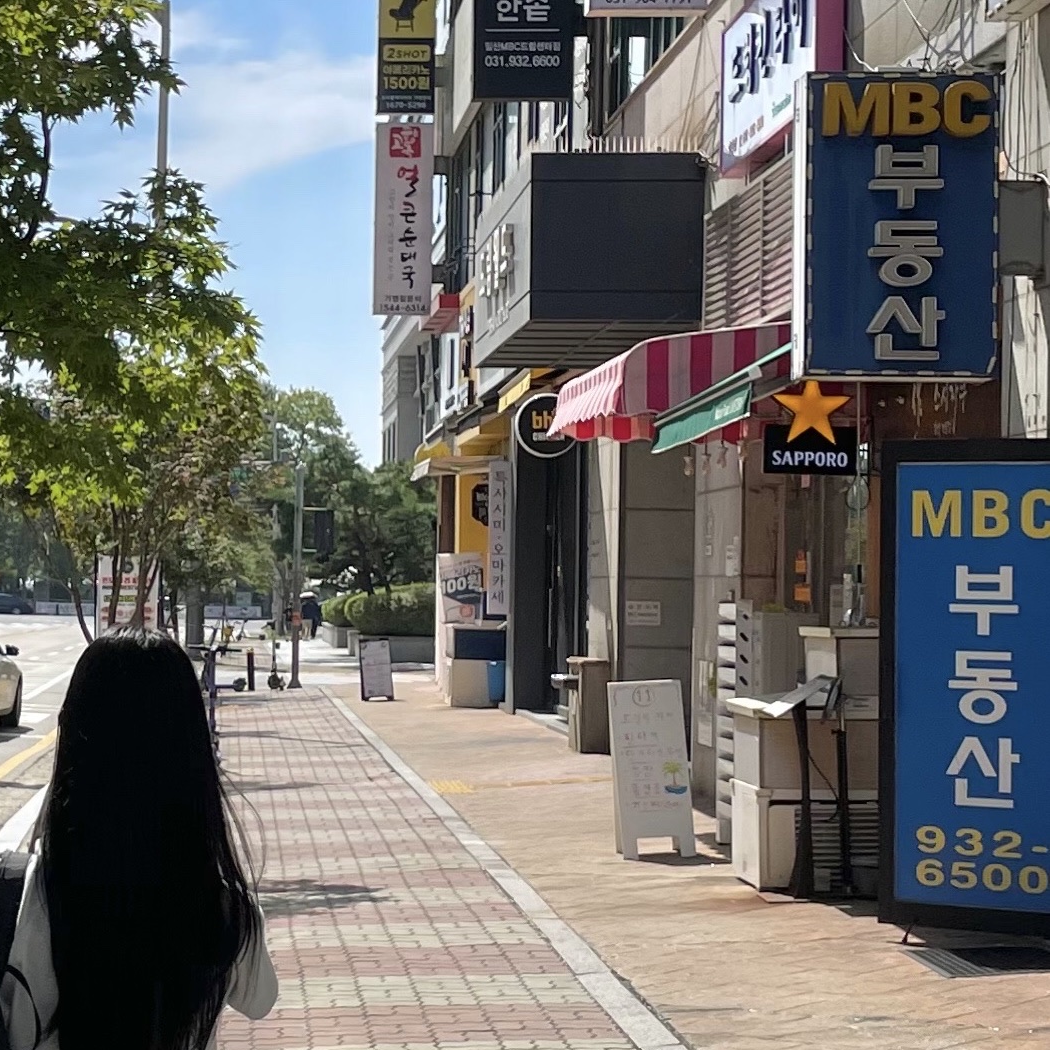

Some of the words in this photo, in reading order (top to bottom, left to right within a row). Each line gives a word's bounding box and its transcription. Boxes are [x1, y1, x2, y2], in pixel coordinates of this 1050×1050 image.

[387, 48, 427, 59] 2SHOT
[484, 55, 560, 68] 031.932.6600
[383, 76, 430, 90] 1500원
[821, 80, 992, 137] MBC
[865, 144, 946, 361] 부동산
[532, 410, 556, 430] bh
[772, 450, 848, 468] SAPPORO
[912, 488, 1050, 540] MBC
[946, 565, 1020, 809] 부동산
[915, 825, 1049, 859] 932-
[915, 858, 1049, 894] 6500
